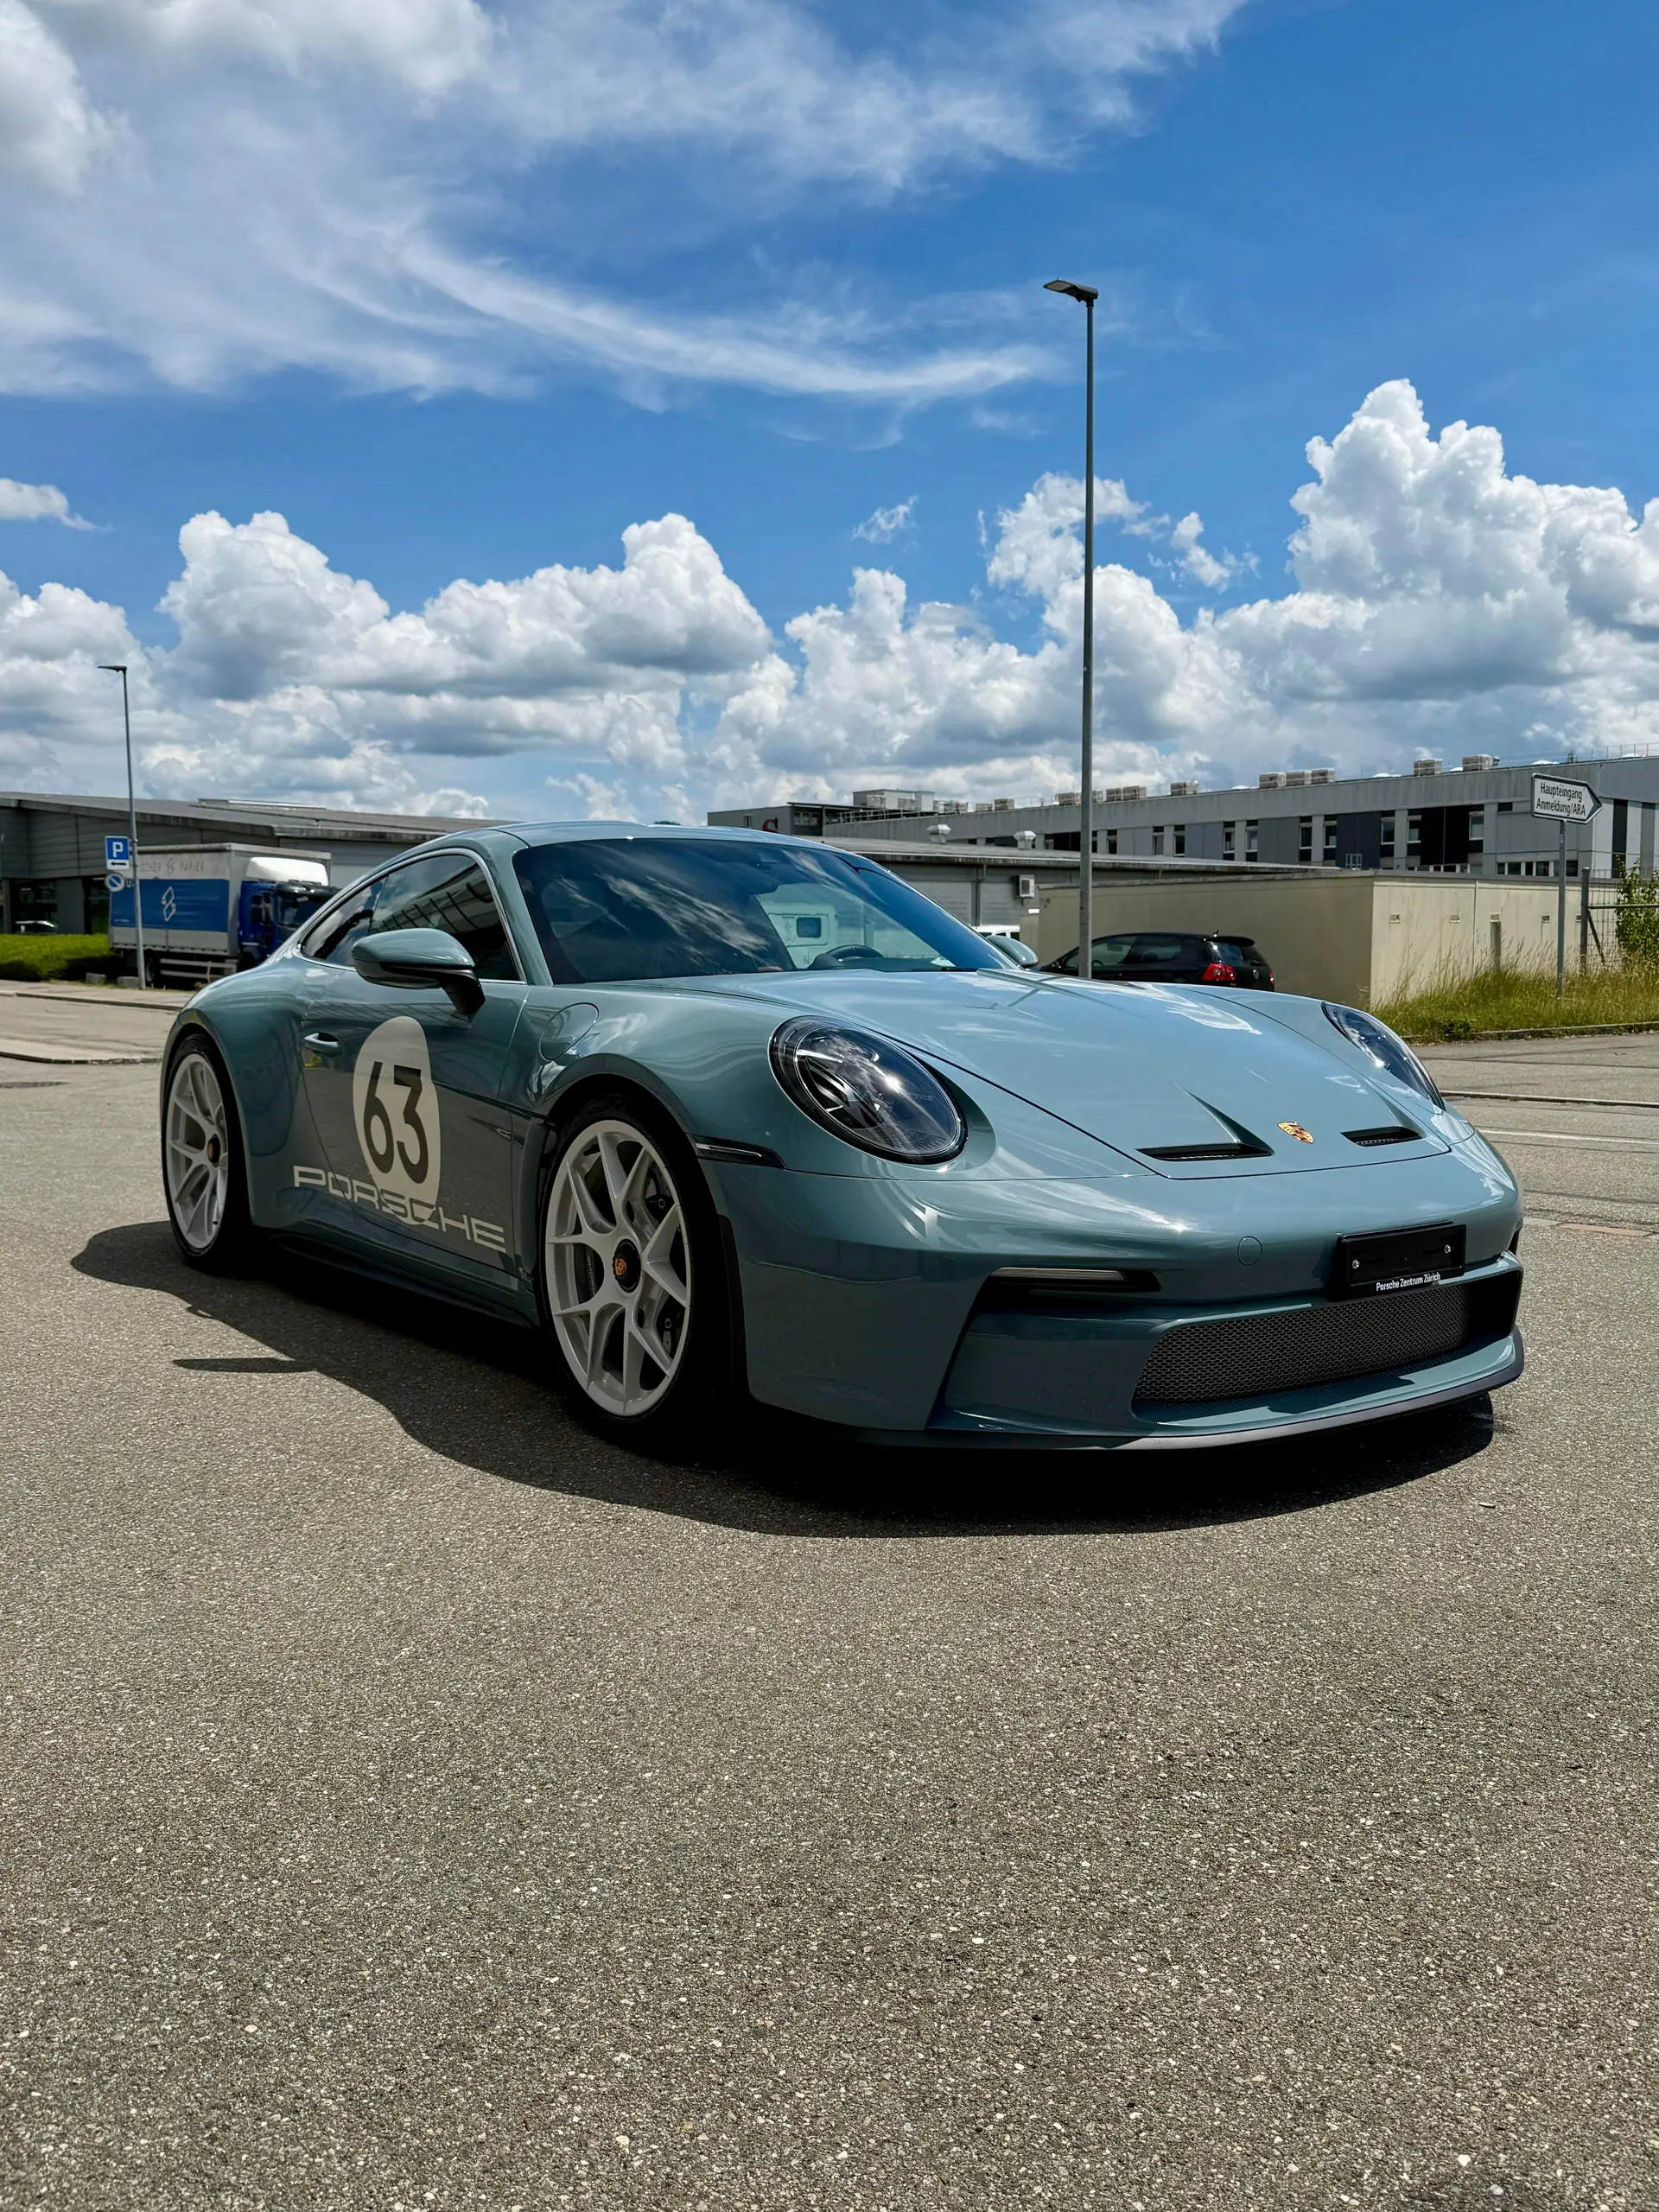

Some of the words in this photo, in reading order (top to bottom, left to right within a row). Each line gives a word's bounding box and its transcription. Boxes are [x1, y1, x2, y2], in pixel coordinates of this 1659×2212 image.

[1541, 782, 1582, 802] Haupteingang
[1536, 798, 1586, 817] Anmeldung/ARA
[112, 841, 124, 858] P
[363, 1061, 429, 1184] 63
[293, 1165, 506, 1254] PORSCHE
[1376, 1280, 1400, 1292] Porsche
[1400, 1277, 1423, 1287] Zentrum
[1423, 1271, 1441, 1283] Zürich
